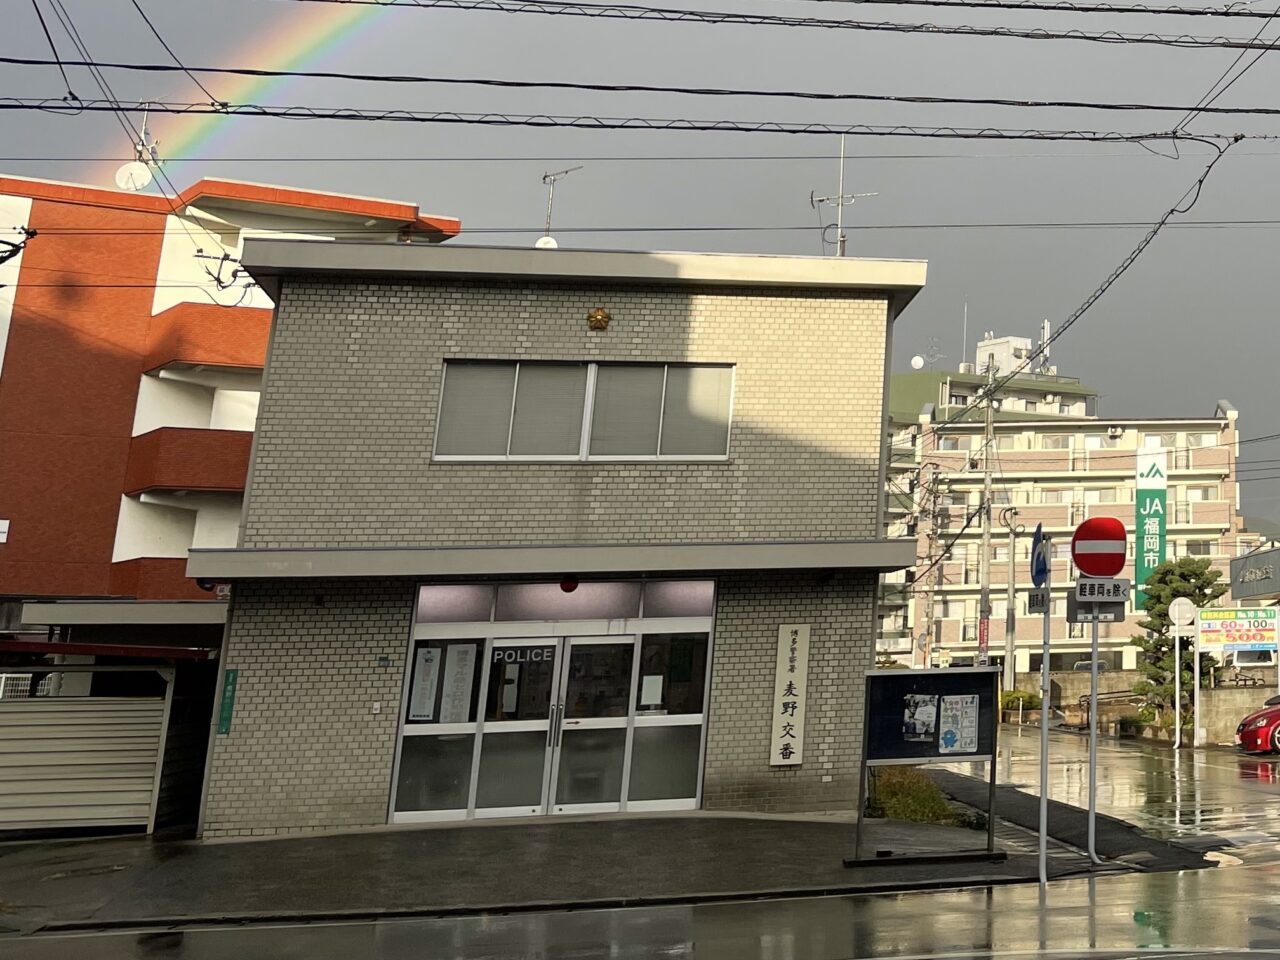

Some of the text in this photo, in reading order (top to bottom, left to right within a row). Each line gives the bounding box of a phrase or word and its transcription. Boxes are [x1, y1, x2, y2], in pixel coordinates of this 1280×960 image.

[1079, 583, 1127, 597] 軽車両を除く
[494, 649, 552, 662] POLICE
[779, 681, 799, 760] 麦野交番
